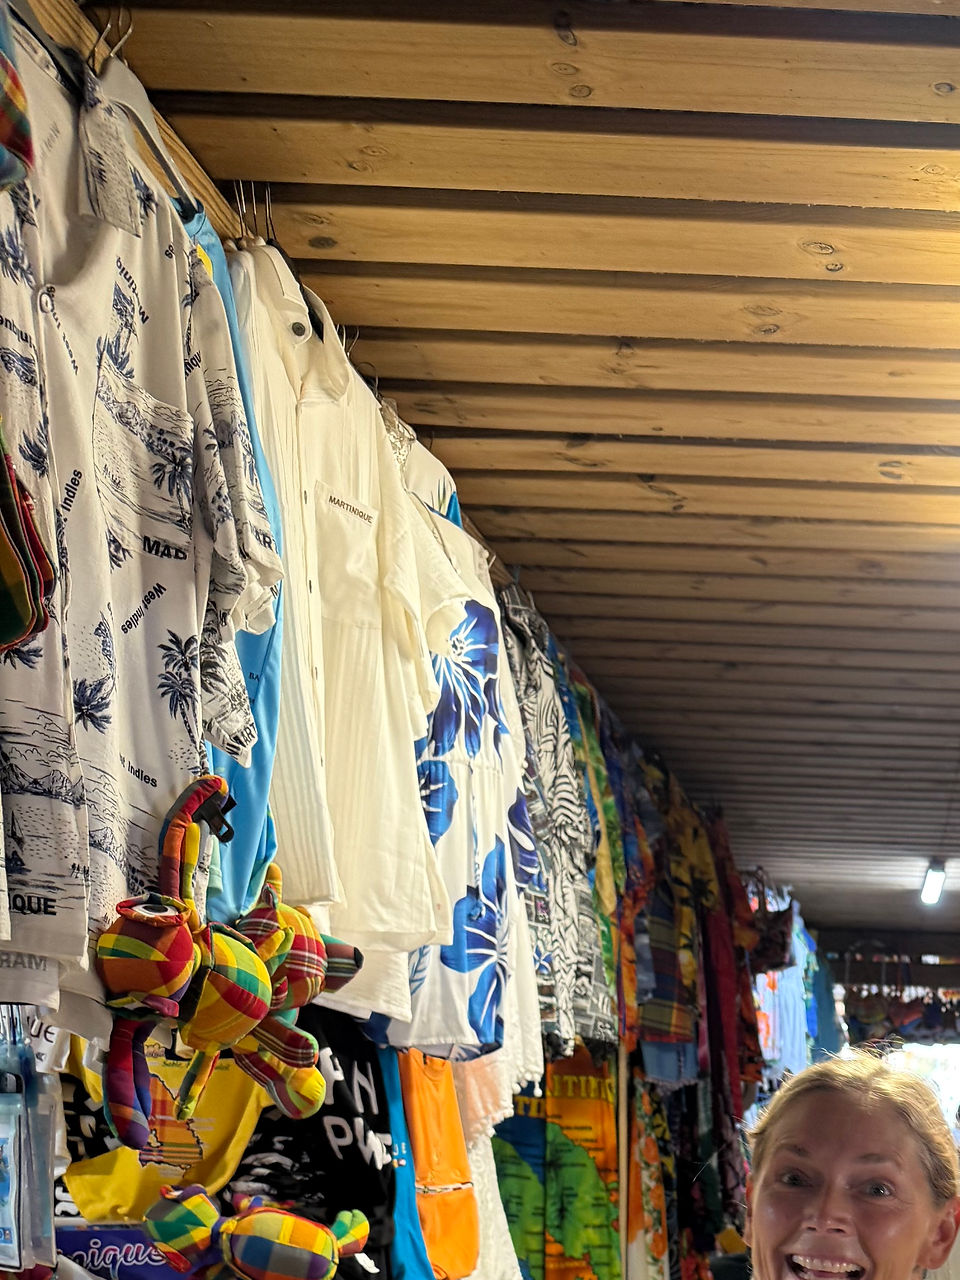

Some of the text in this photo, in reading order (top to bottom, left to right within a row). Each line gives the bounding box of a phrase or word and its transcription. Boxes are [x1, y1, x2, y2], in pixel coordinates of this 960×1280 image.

[328, 495, 373, 524] MARTINIQUE
[143, 582, 167, 609] West
[127, 761, 157, 788] Indies
